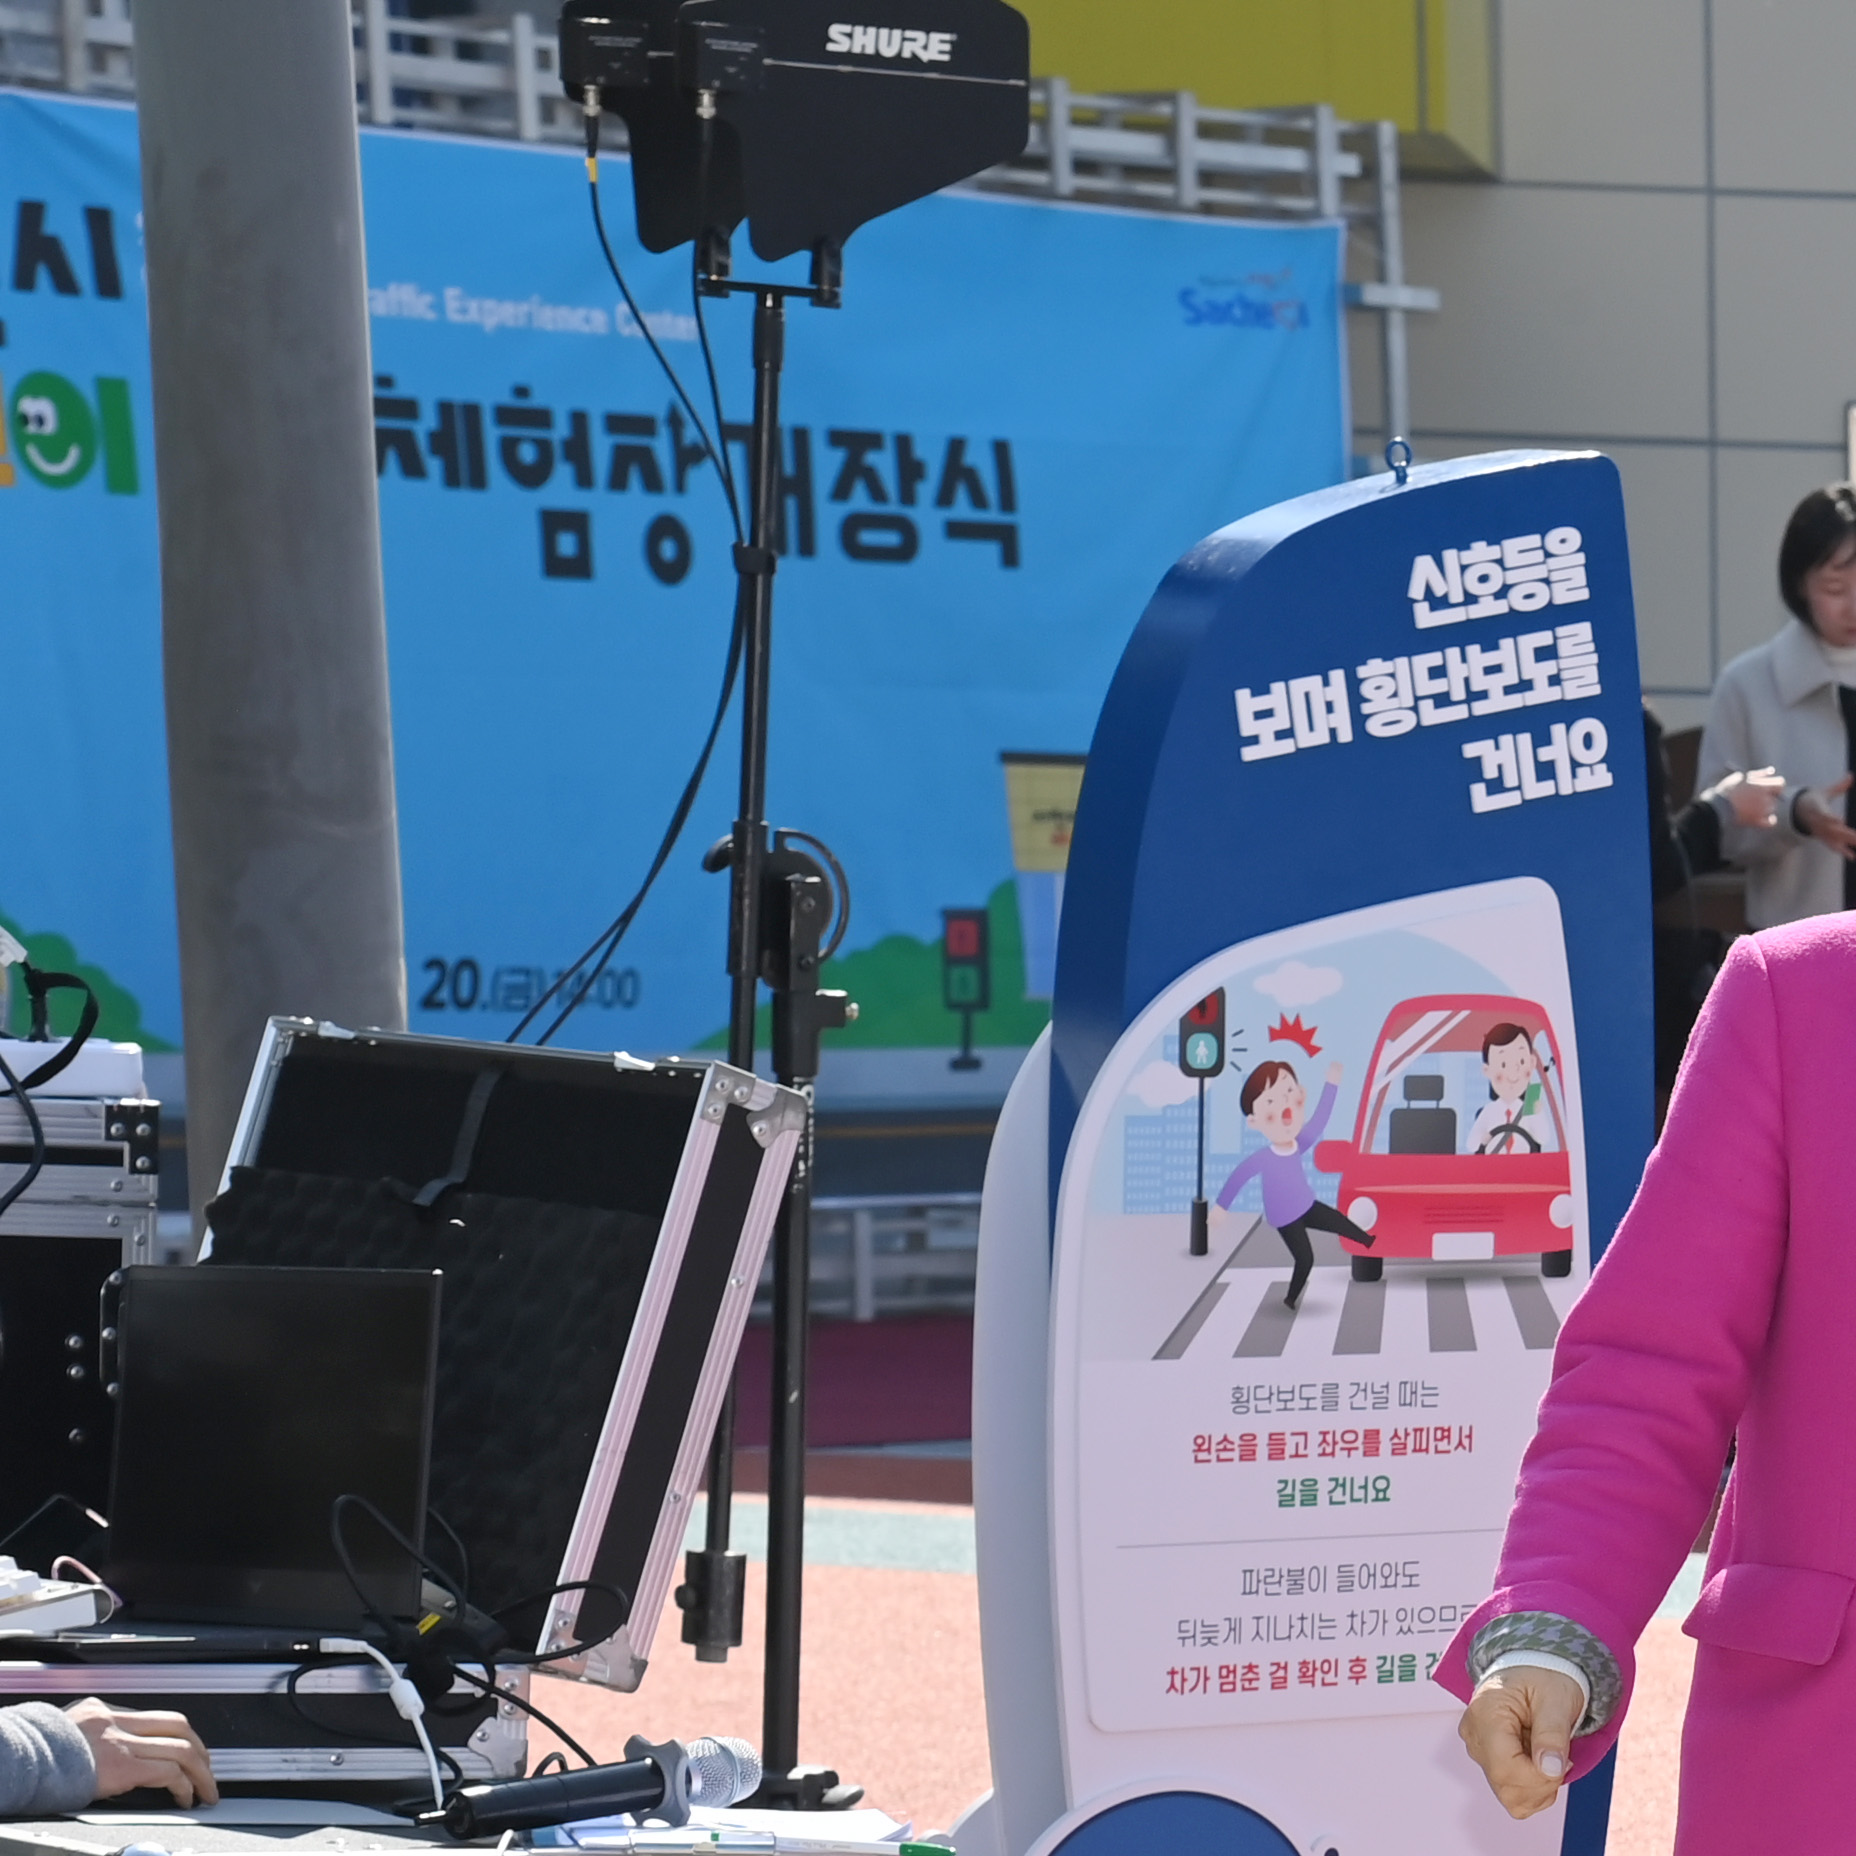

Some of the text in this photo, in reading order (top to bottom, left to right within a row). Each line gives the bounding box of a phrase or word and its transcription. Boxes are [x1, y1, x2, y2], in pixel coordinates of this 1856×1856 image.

[825, 23, 953, 63] SHURE
[444, 286, 609, 332] Experience
[1407, 525, 1591, 630] 신호등을
[1234, 621, 1602, 763] 보며 횡단보도를
[1460, 716, 1614, 815] 건너요
[1229, 1379, 1441, 1417] 횡단보도를 건널 때는
[1191, 1425, 1475, 1466] 왼손을 들고 좌우를 살피면서
[1276, 1475, 1392, 1509] 길을 건너요
[1240, 1560, 1422, 1598] 파란불이 들어와도
[1176, 1616, 1243, 1649] 뒤늦게
[1250, 1611, 1338, 1644] 지나치는
[1345, 1608, 1389, 1639] 차가
[1164, 1665, 1211, 1697] 차가
[1217, 1661, 1261, 1695] 멈춘
[1268, 1661, 1289, 1691] 걸
[1297, 1657, 1340, 1690] 확인
[1347, 1656, 1368, 1686] 후
[1375, 1653, 1418, 1684] 길을
